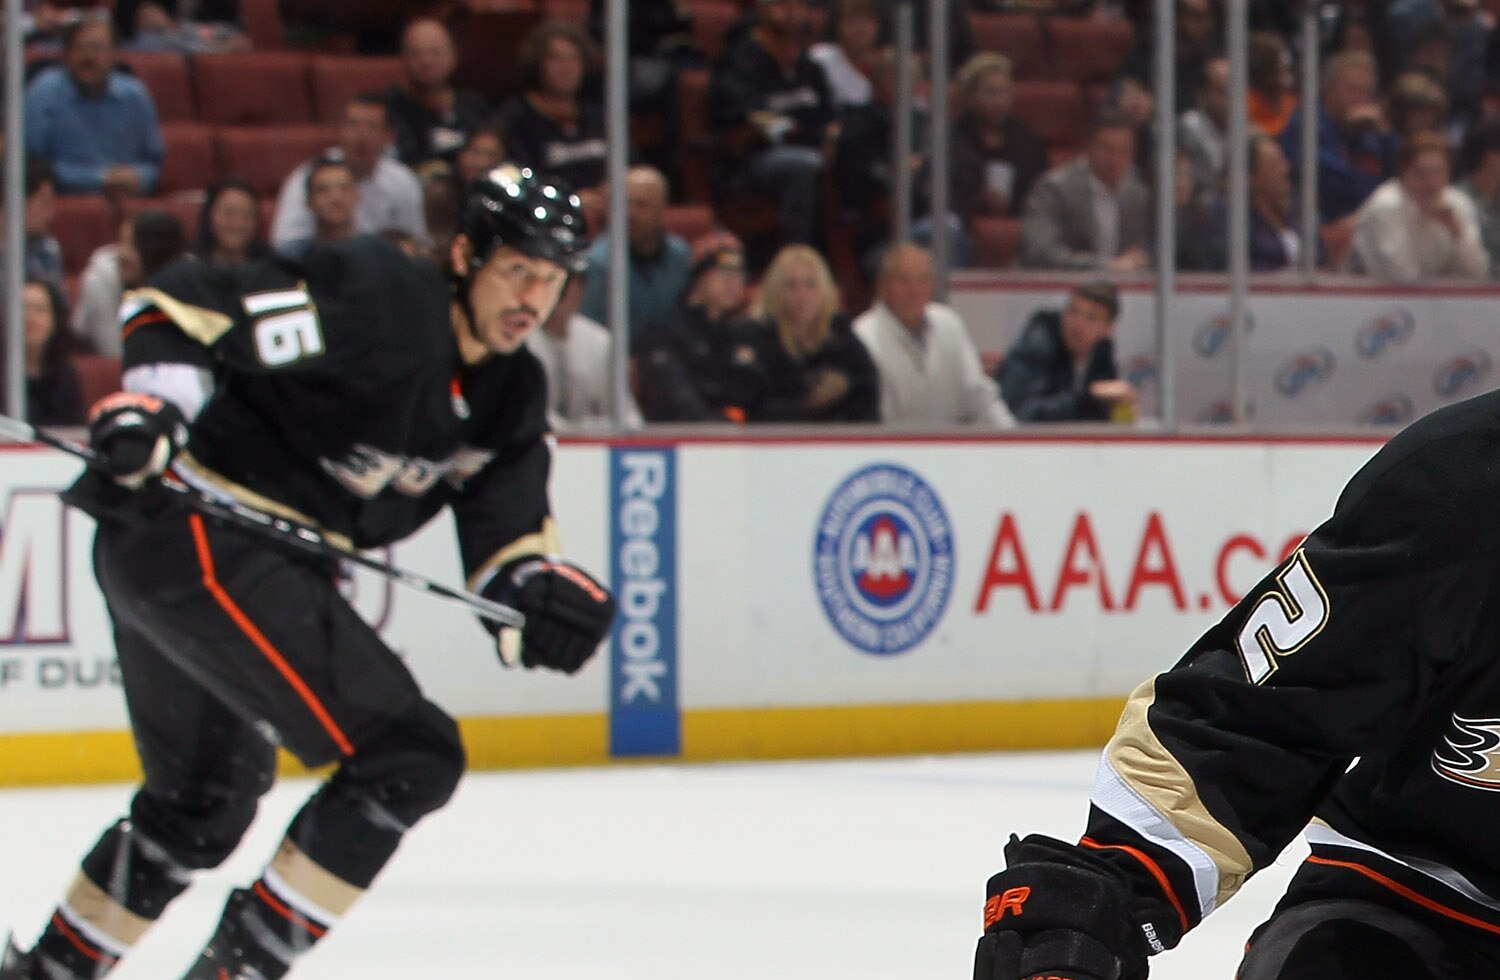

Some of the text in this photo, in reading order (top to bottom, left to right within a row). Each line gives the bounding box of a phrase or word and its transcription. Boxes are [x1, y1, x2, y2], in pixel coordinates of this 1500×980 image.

[241, 279, 326, 368] 16
[620, 453, 668, 702] Reebok
[1235, 547, 1330, 686] 2
